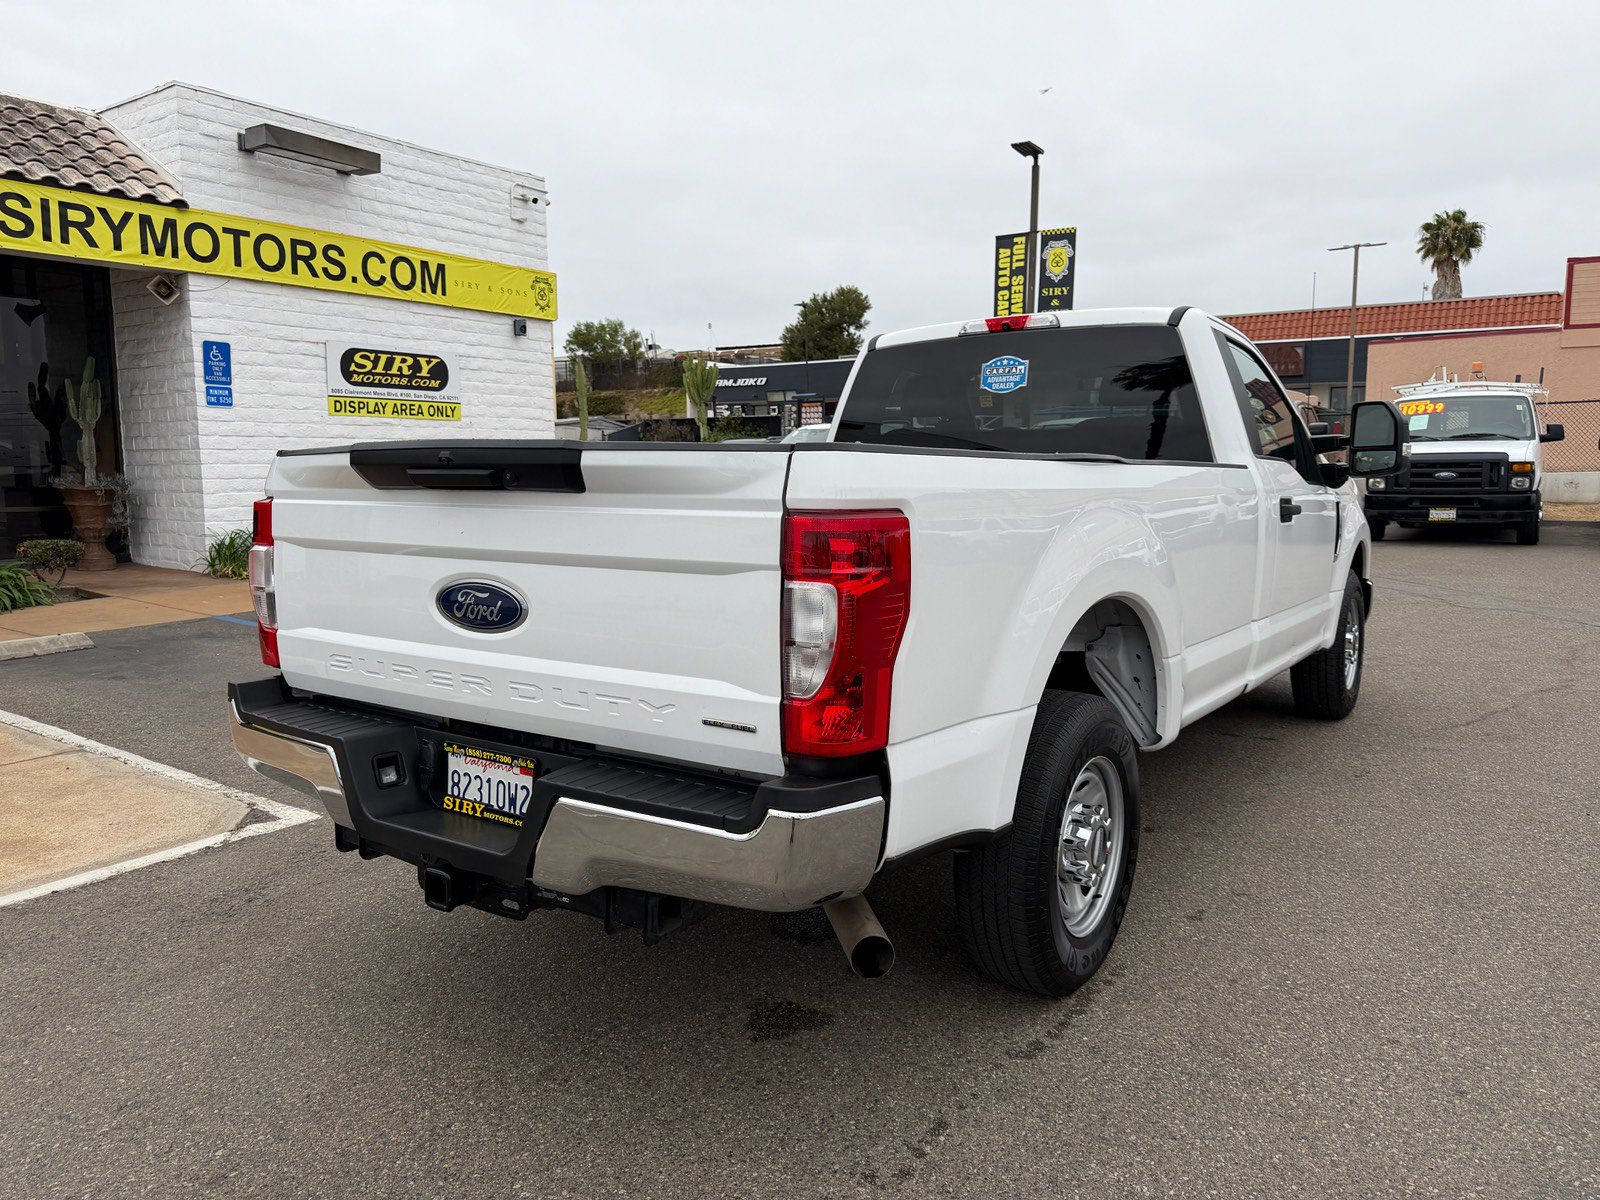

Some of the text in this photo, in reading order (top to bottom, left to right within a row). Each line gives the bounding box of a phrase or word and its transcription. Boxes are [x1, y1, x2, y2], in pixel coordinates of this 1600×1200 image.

[0, 191, 447, 297] SIRYMOTORS.COM
[1012, 236, 1026, 270] FULL
[998, 248, 1011, 287] AUTO
[454, 280, 480, 290] SIRY
[500, 287, 528, 297] SONS
[1041, 287, 1069, 296] SIRY
[1051, 298, 1060, 306] &
[349, 351, 441, 377] SIRY
[986, 366, 1024, 375] CARFAX
[350, 374, 441, 388] MOTORS.COM
[987, 375, 1021, 383] ADVANTAGE
[334, 400, 457, 418] DISPLAY AREA ONLY
[453, 589, 502, 621] Ford
[329, 653, 676, 722] SUPER DUTY
[465, 747, 483, 759] (858)
[483, 751, 512, 764] 277-7300
[451, 769, 530, 816] 82310W2
[443, 796, 486, 818] SIRY
